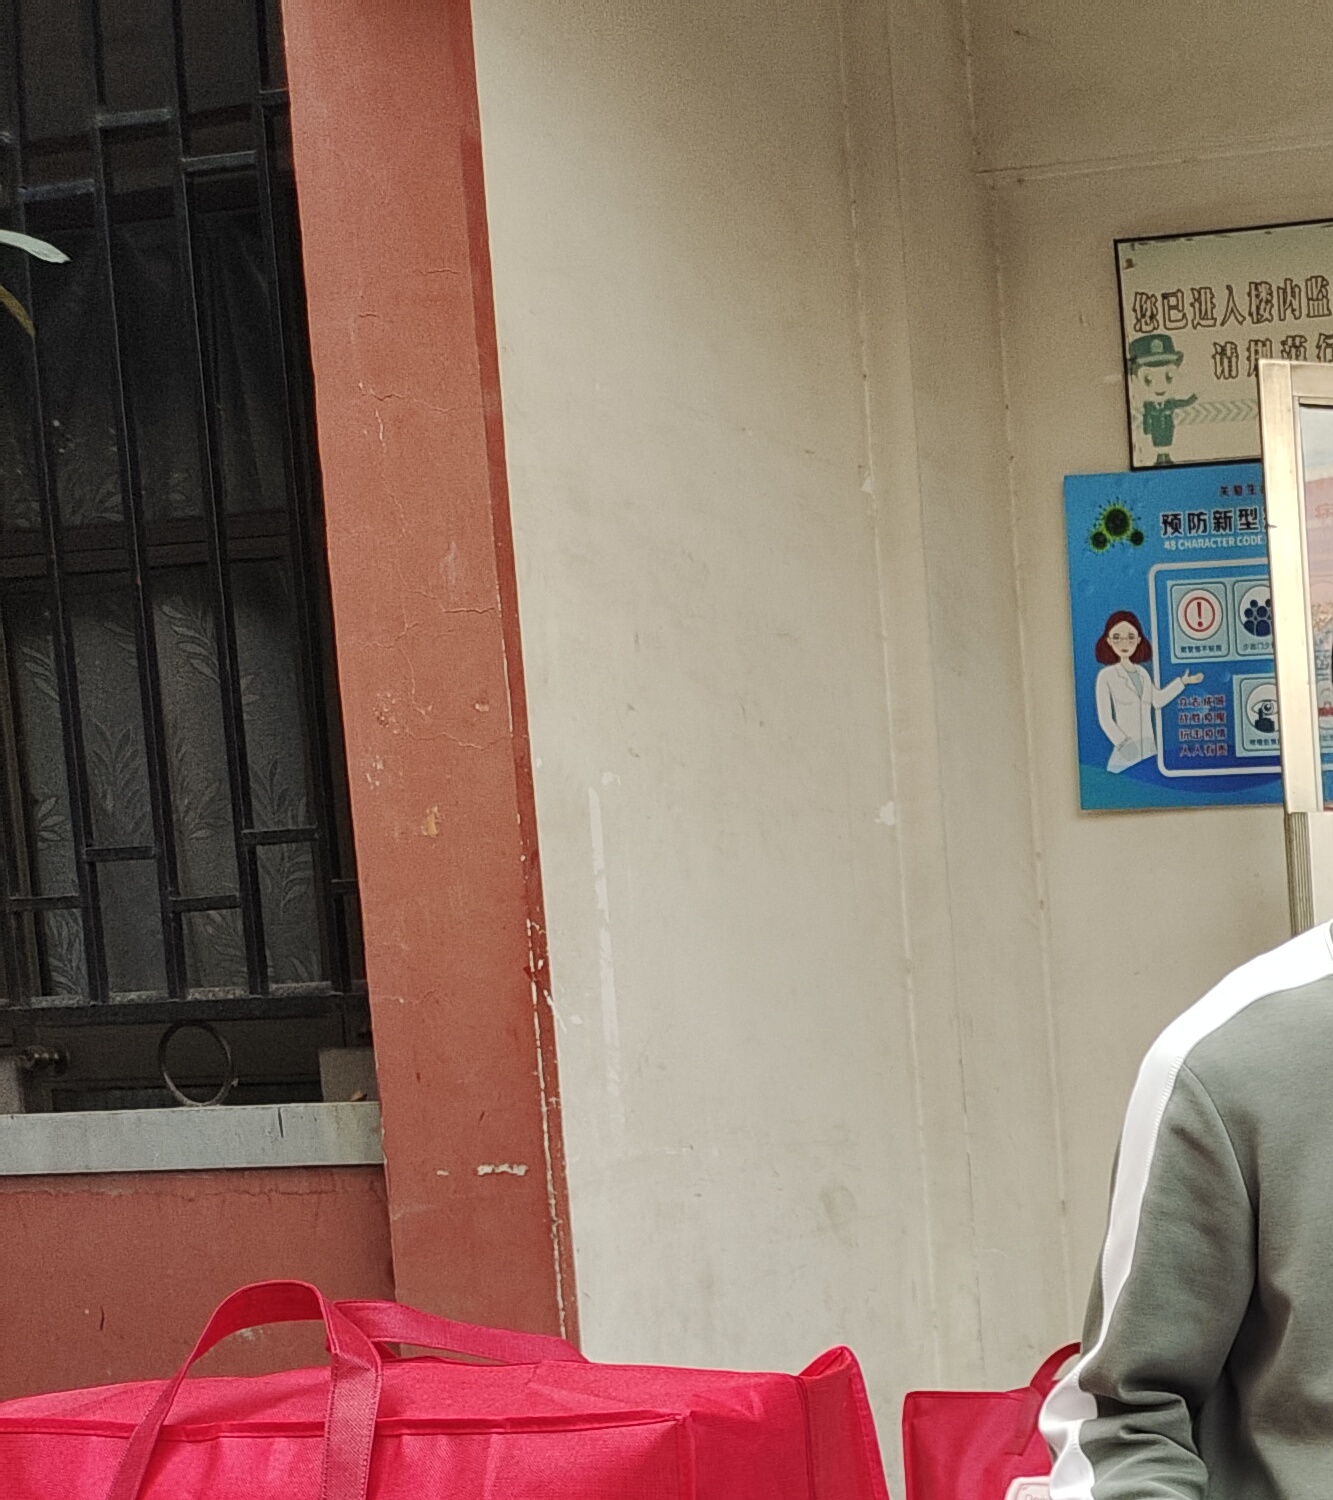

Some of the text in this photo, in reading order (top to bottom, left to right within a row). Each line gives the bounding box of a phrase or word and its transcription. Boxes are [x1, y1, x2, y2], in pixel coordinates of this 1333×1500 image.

[1159, 506, 1266, 537] 预防新型
[1178, 536, 1235, 550] CHARACTER
[1236, 534, 1263, 546] CODE
